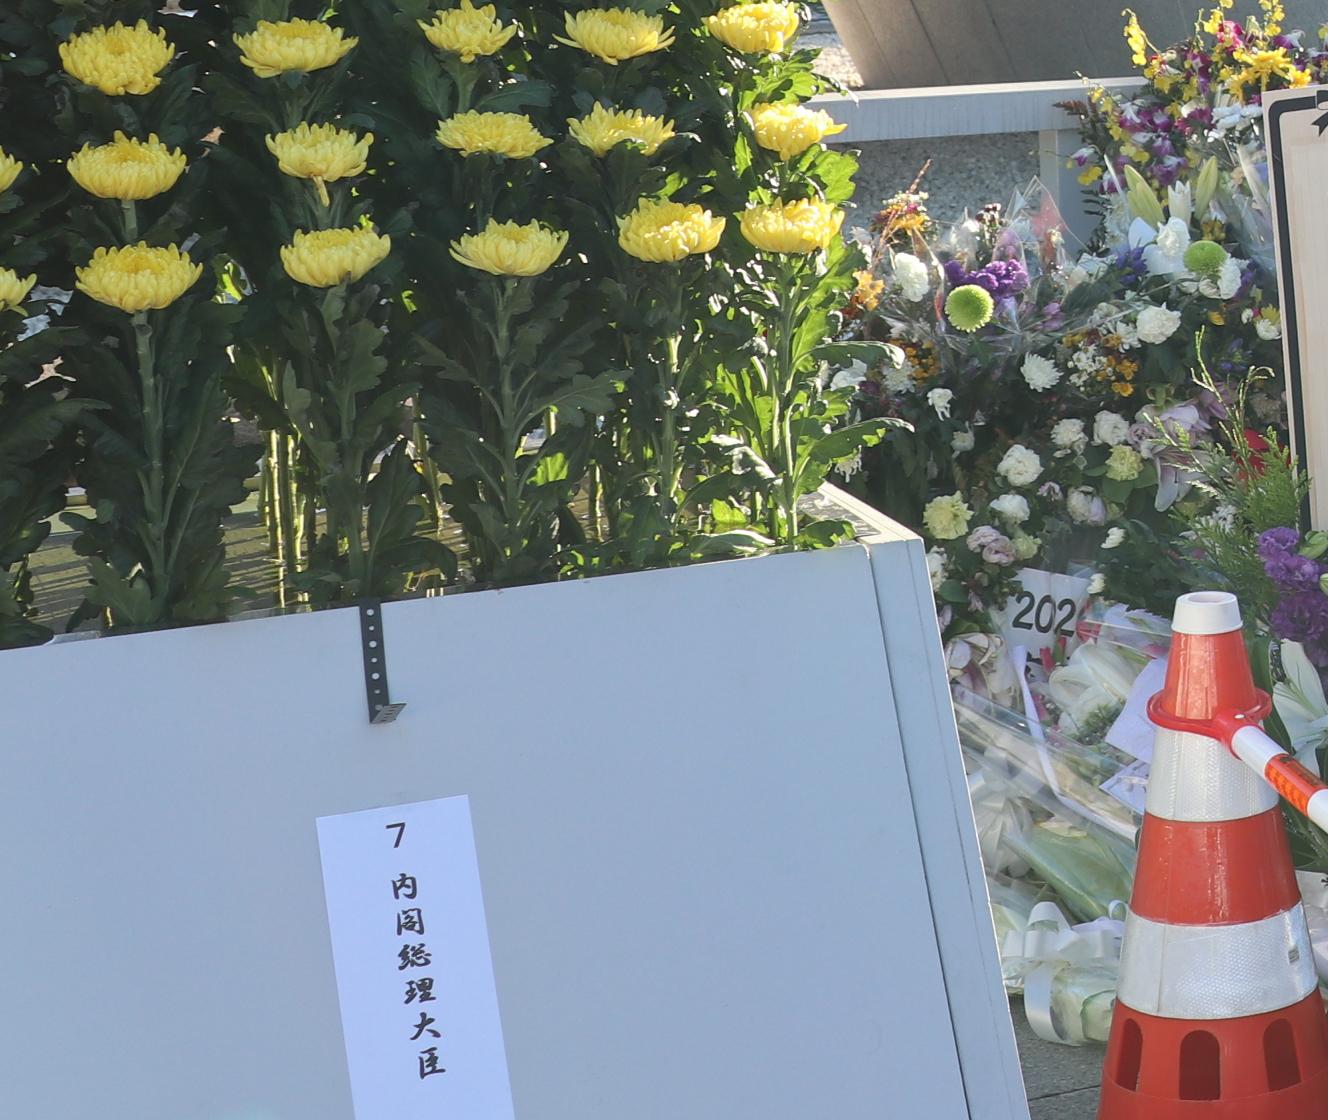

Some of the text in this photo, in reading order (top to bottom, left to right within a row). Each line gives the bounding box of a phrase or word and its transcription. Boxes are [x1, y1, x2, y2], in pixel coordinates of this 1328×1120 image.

[385, 822, 446, 1080] 7 内閣総理大臣
